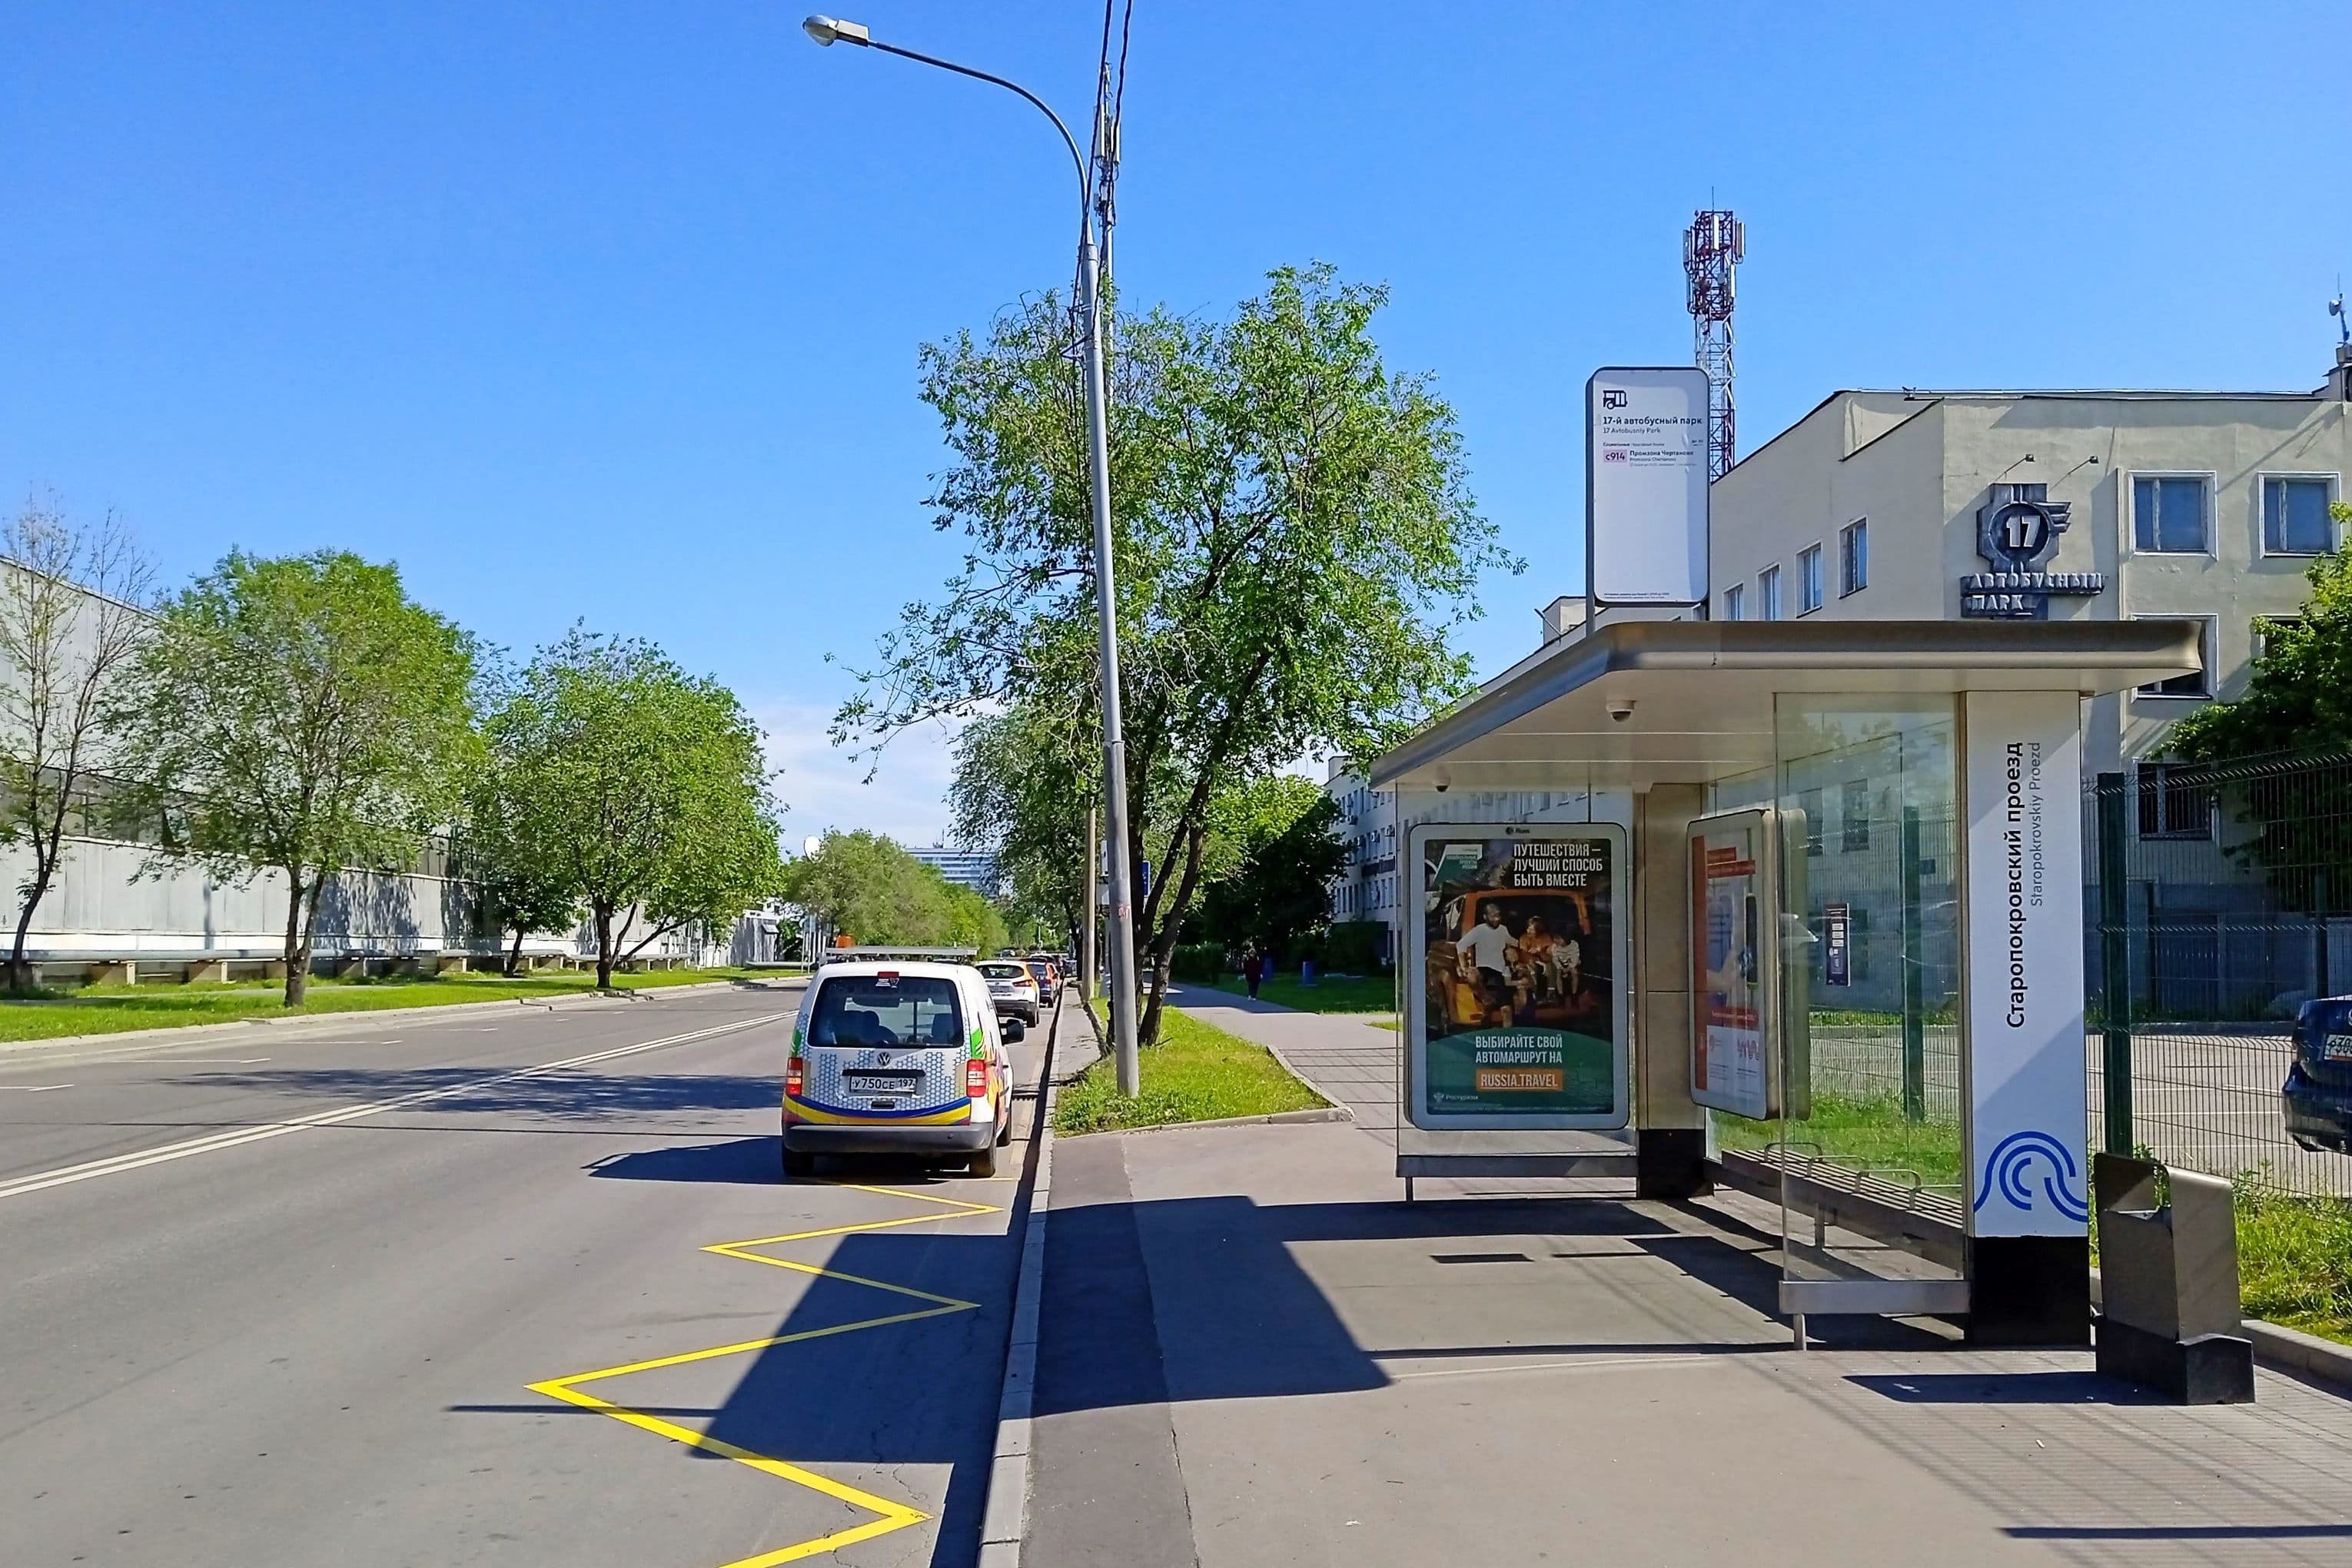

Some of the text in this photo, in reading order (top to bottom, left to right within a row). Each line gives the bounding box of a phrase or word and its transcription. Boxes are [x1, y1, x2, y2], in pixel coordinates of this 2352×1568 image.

[1603, 416, 1703, 426] 17-й автобусный парк
[2005, 515, 2041, 547] 17
[1969, 572, 2104, 589] АВТОБУСНЫЙ
[1972, 594, 2024, 610] ПАРК
[2028, 742, 2045, 906] Staropokrovskiy Proezd
[1513, 844, 1590, 857] ПУТЕШЕСТВИЯ
[1513, 856, 1603, 872] ЛУЧШИЙ СПОСОБ
[1513, 873, 1587, 886] БЫТЬ ВМЕСТЕ
[2003, 742, 2028, 1028] Старопокровский проезд
[1475, 1034, 1563, 1048] ВЫБИРАЙТЕ СВОЙ
[1475, 1051, 1563, 1064] АВТОМАРШРУТ НА
[1481, 1073, 1558, 1088] RUSSIA.TRAVEL
